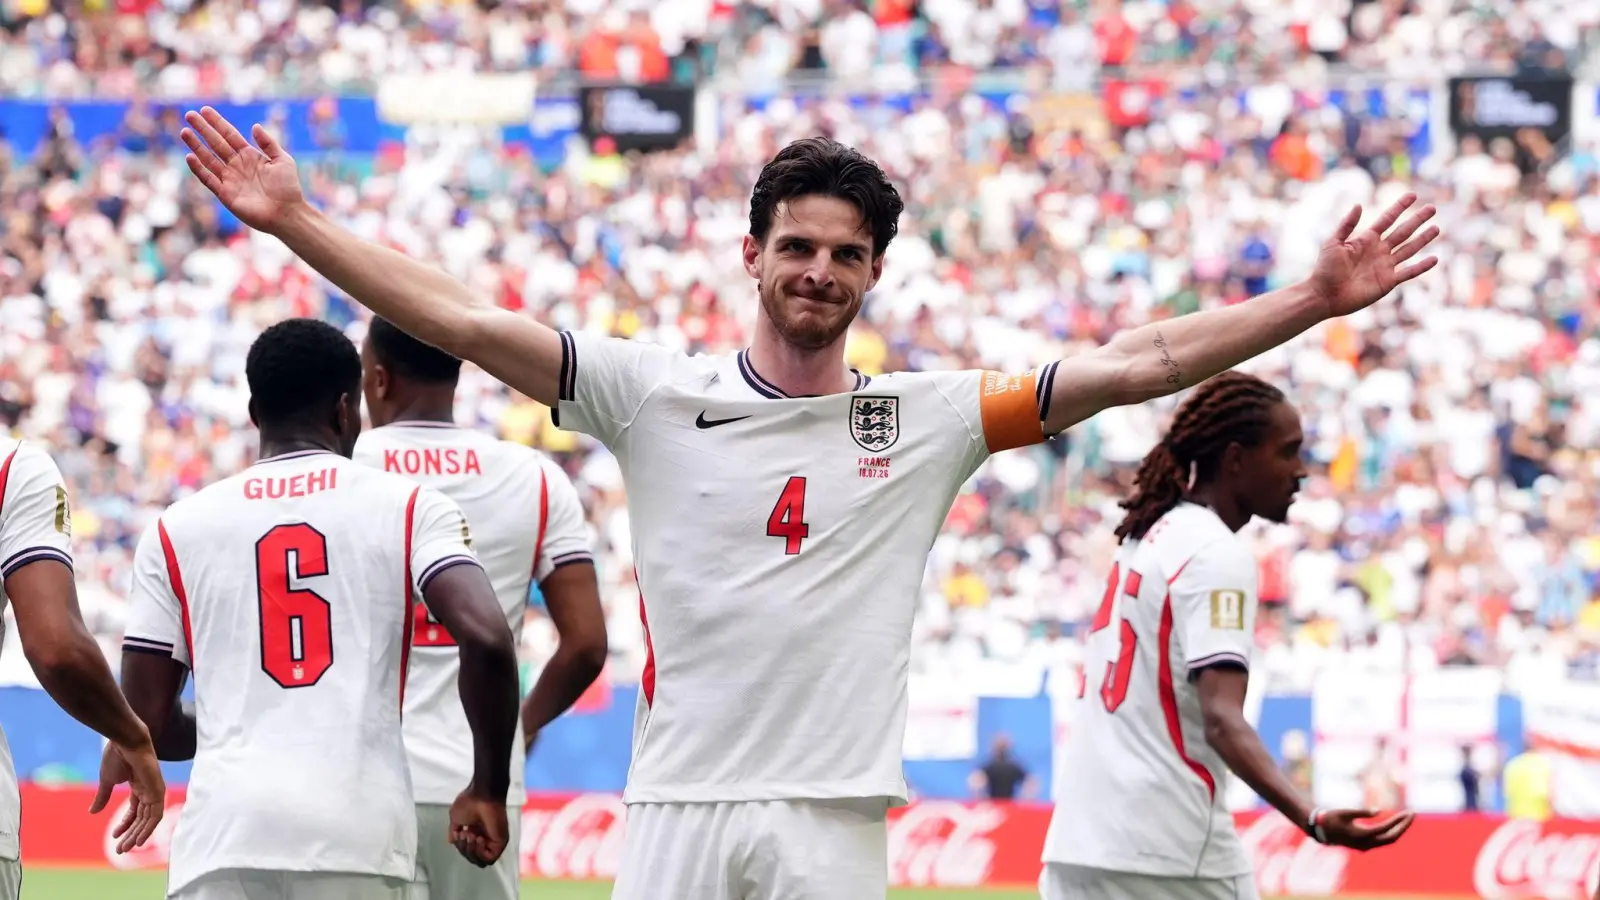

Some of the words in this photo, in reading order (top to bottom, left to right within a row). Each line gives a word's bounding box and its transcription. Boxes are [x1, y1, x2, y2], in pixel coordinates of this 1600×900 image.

[384, 449, 482, 475] KONSA
[858, 456, 891, 467] FRANCE
[243, 468, 338, 500] GUEHI
[766, 476, 809, 555] 4
[255, 522, 334, 688] 6
